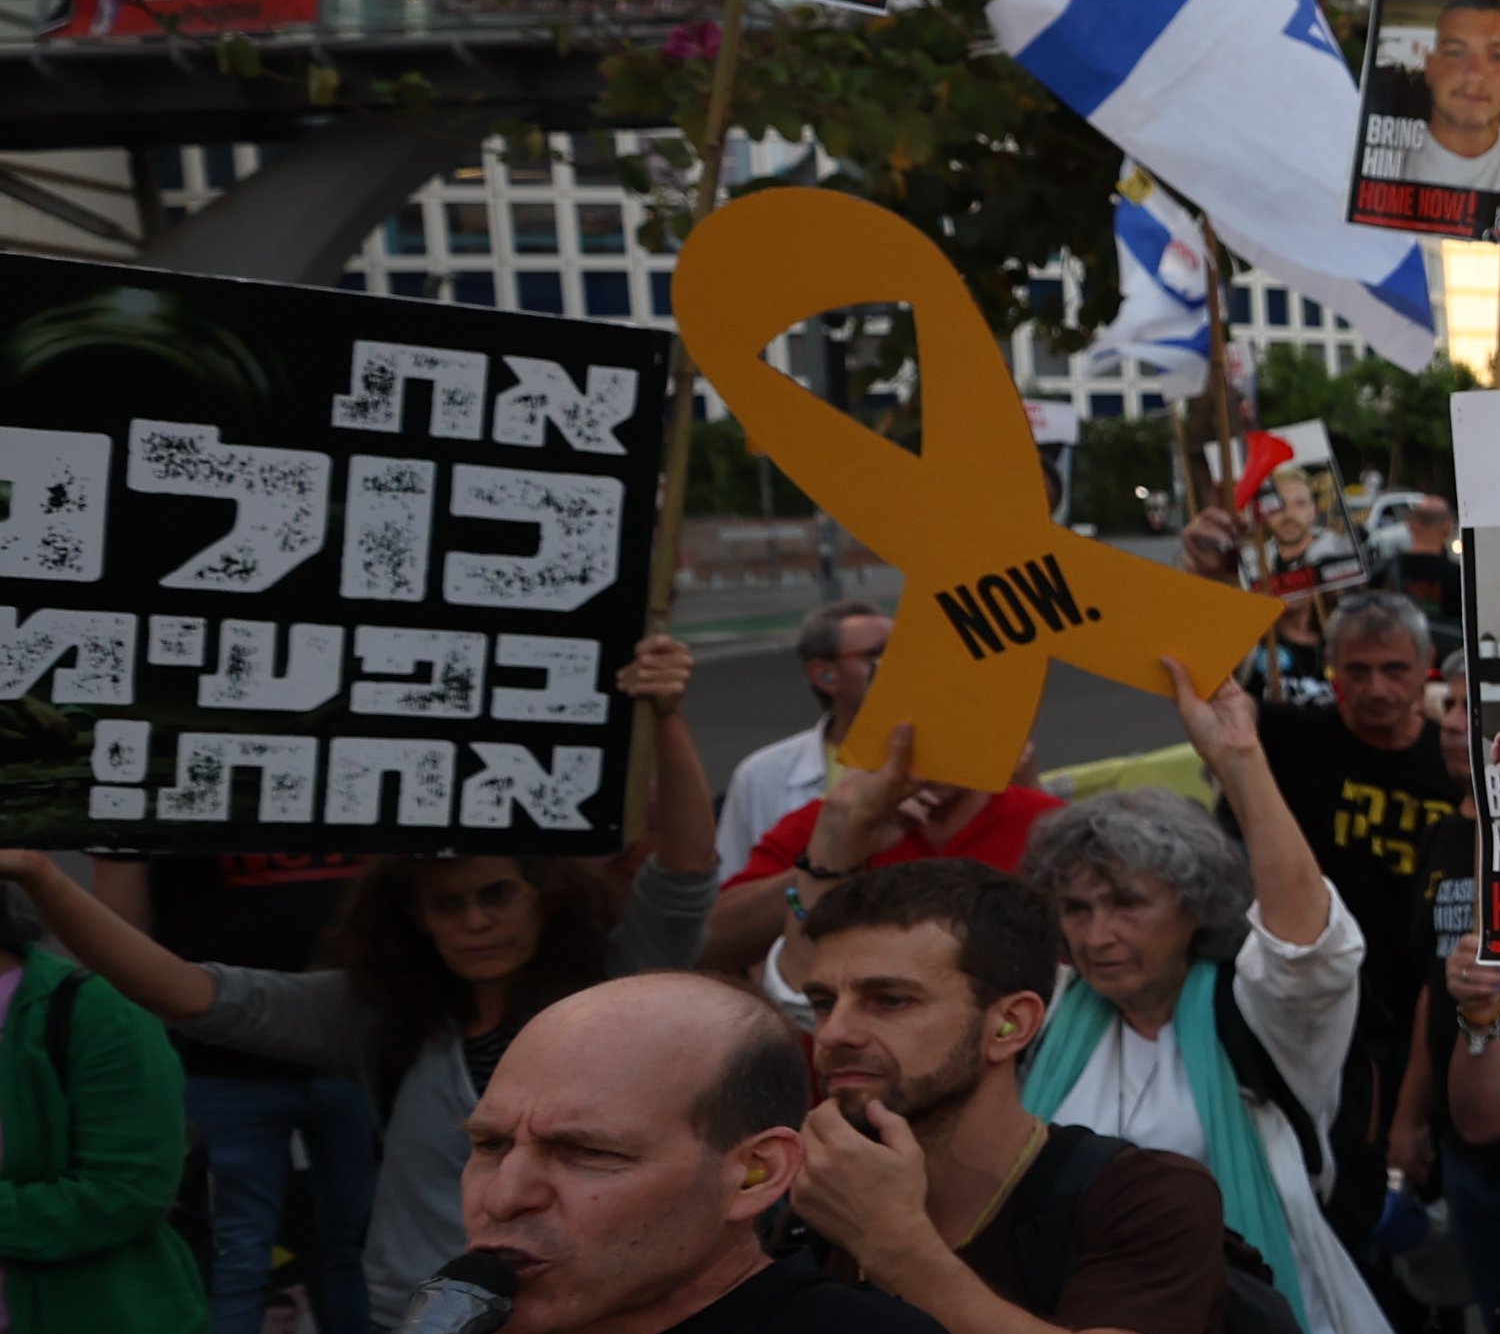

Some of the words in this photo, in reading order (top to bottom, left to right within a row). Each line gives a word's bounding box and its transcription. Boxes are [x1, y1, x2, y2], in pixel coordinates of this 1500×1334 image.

[1361, 145, 1401, 180] HIM
[1366, 113, 1427, 149] BRING
[1356, 178, 1414, 215] HOME
[1418, 187, 1480, 224] NOW!
[331, 339, 639, 456] את
[934, 554, 1103, 661] NOW.
[89, 718, 604, 832] אחת!
